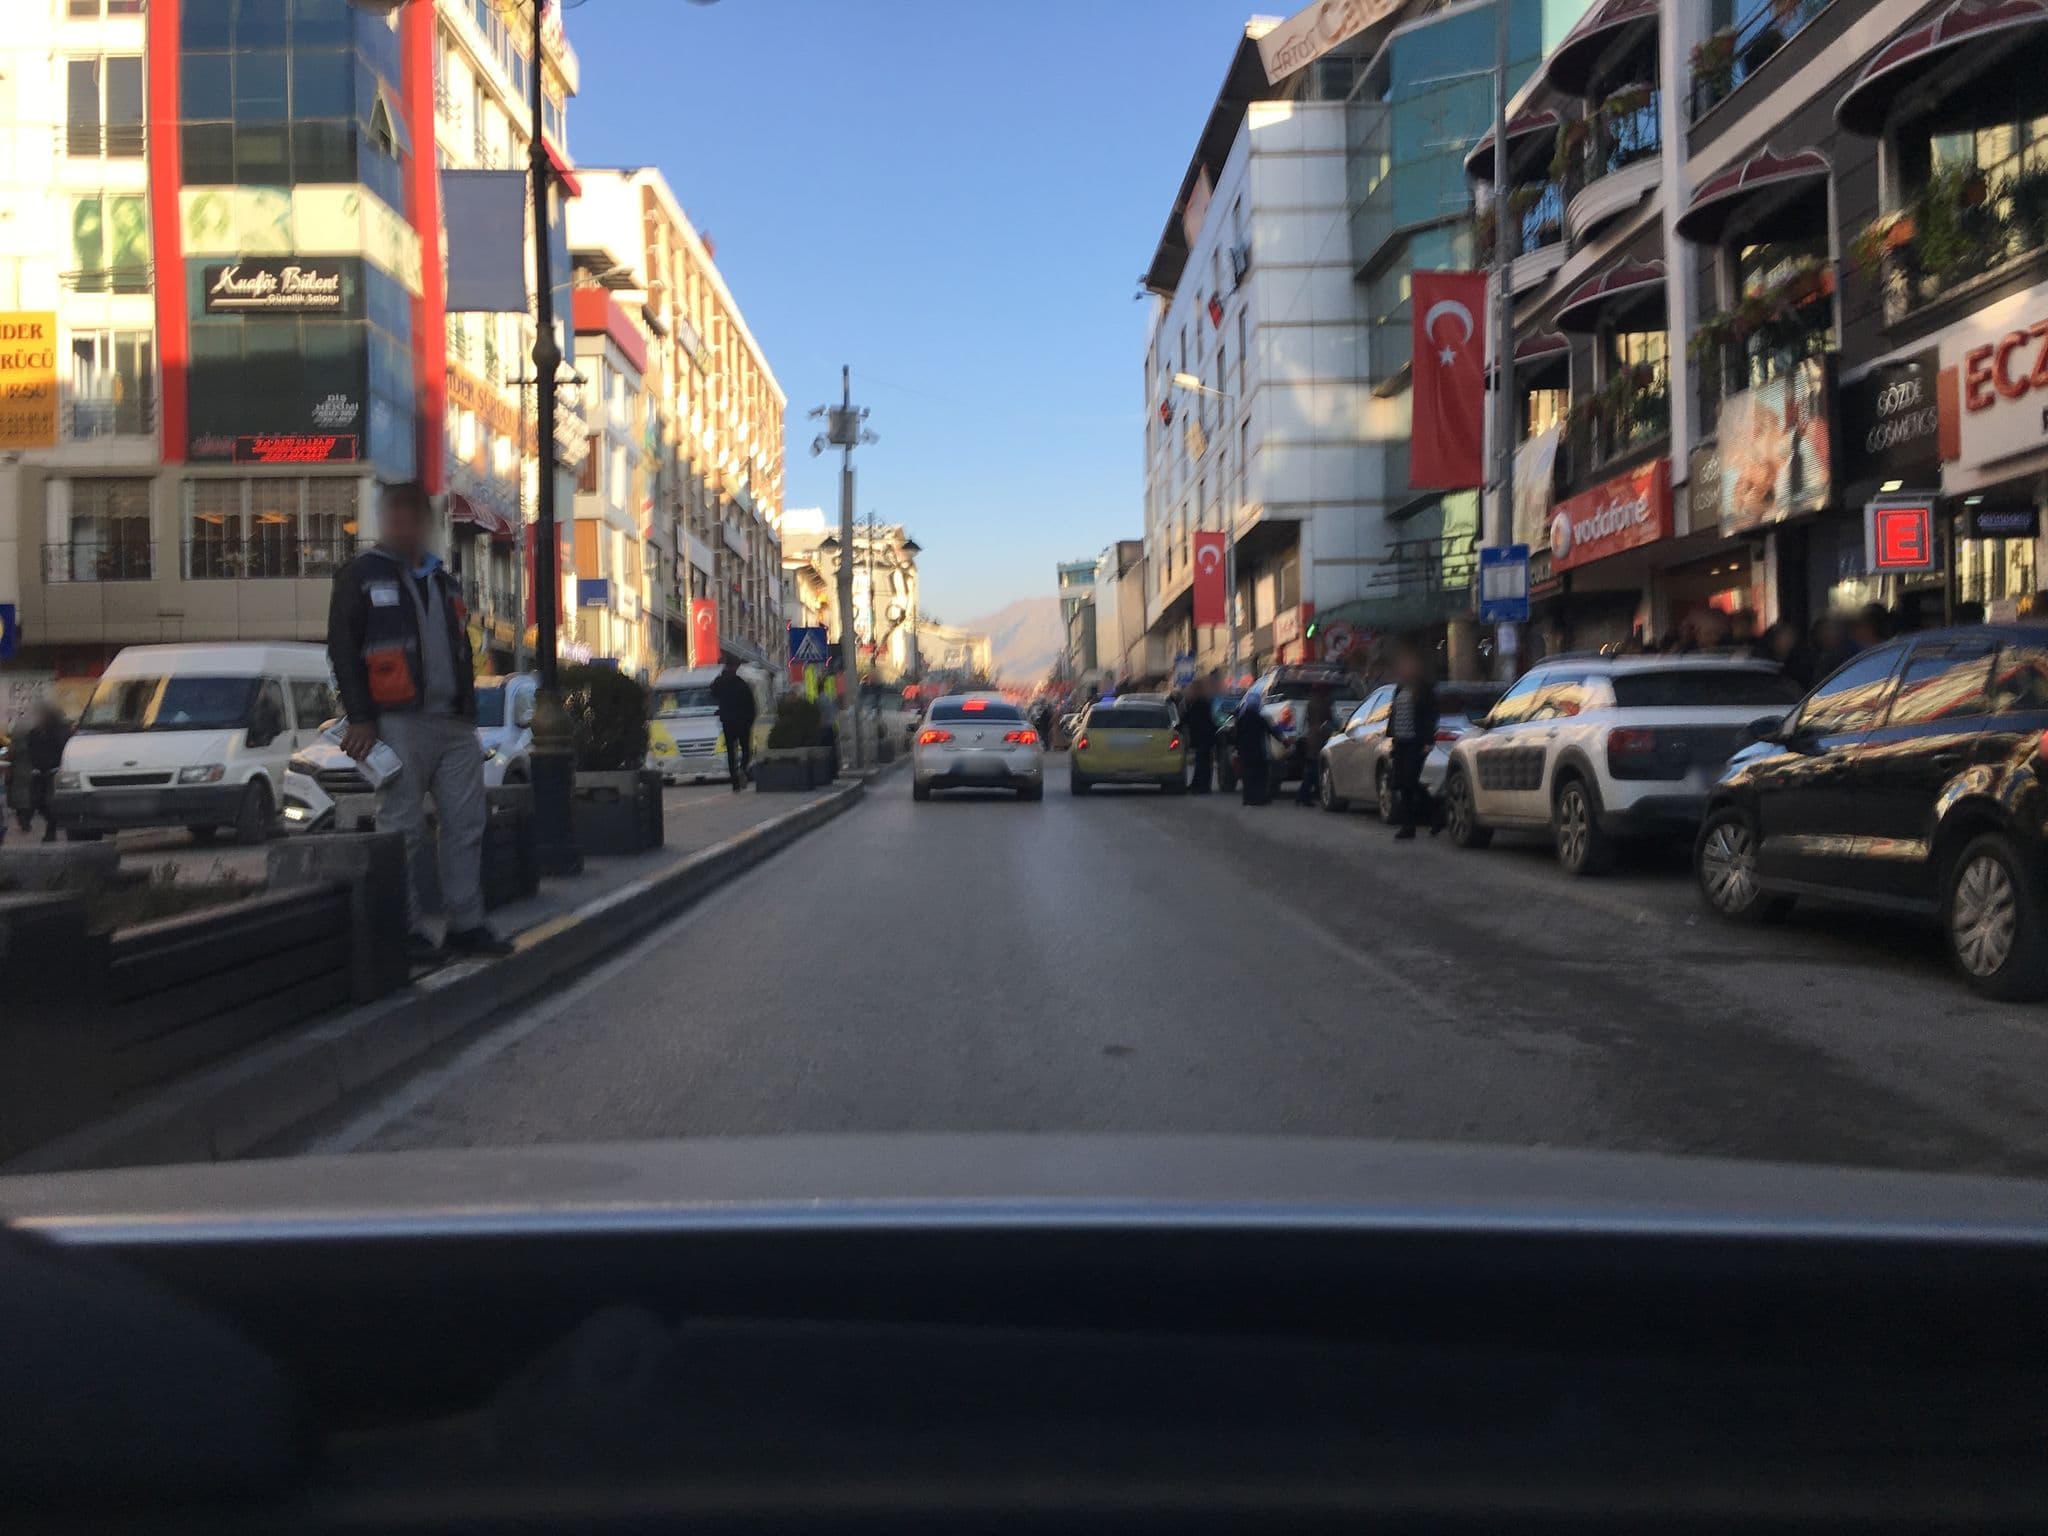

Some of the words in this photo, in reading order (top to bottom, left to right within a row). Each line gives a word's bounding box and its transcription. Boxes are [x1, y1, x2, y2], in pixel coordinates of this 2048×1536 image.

[210, 266, 278, 297] Kuaför
[280, 266, 339, 292] Bülent
[268, 294, 305, 304] Güzellik
[306, 293, 340, 304] Salonu
[0, 323, 43, 340] DER
[1965, 319, 2048, 412] ECZ
[1574, 496, 1649, 546] vodafone
[1886, 514, 1919, 559] E
